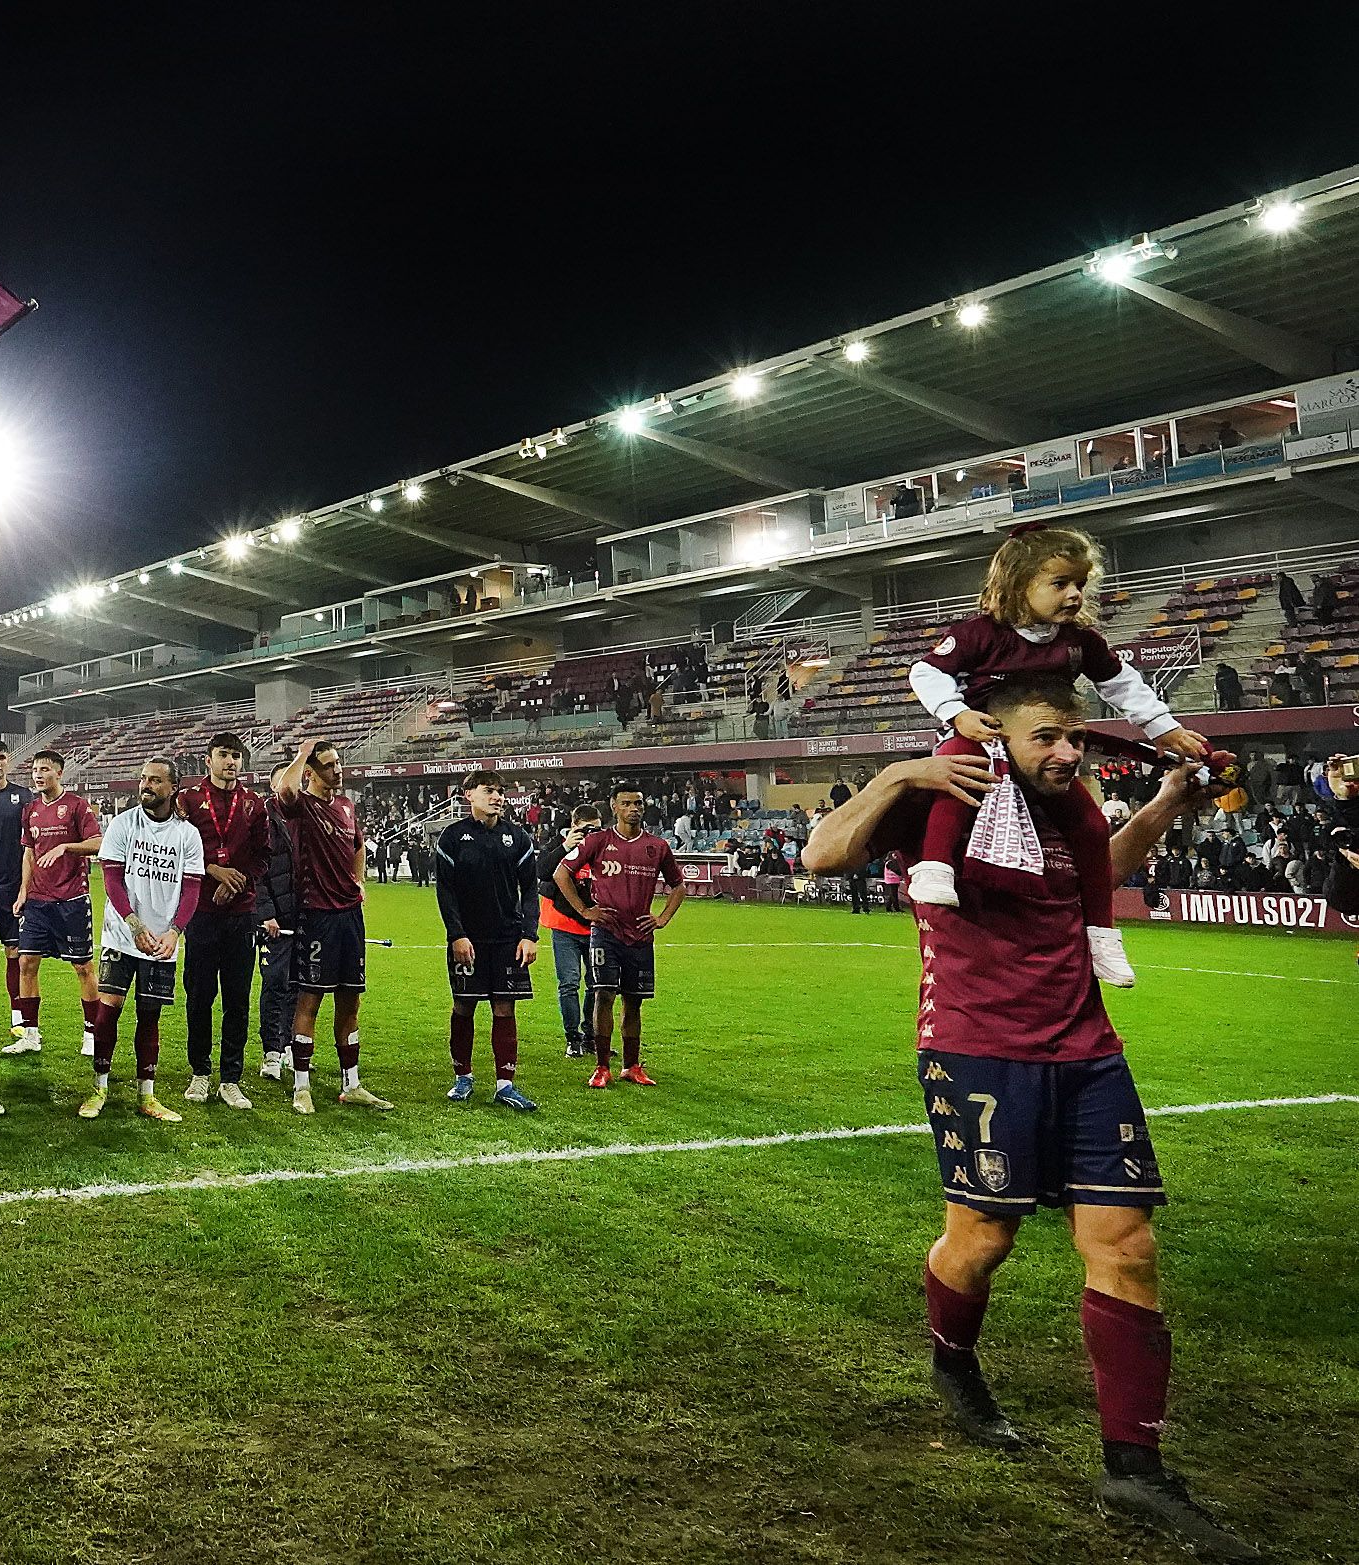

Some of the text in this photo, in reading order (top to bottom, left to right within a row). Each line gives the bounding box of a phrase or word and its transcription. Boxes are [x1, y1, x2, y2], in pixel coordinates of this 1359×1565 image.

[1329, 388, 1357, 399] SAN
[1300, 394, 1358, 413] MARCOS
[1030, 453, 1072, 467] PESCAMAR
[1113, 472, 1165, 487] PESCAMAR
[423, 763, 442, 774] Diario
[448, 761, 483, 773] Pontevedra
[495, 759, 517, 770] Diario
[523, 755, 564, 769] Pontevedra
[134, 839, 178, 857] MUCHA
[132, 852, 176, 870] FUERZA
[1148, 864, 1156, 876] 4
[125, 865, 180, 884] J. CAMBIL
[1180, 893, 1328, 928] IMPULSO27
[309, 940, 322, 963] 2
[967, 1093, 998, 1144] 7
